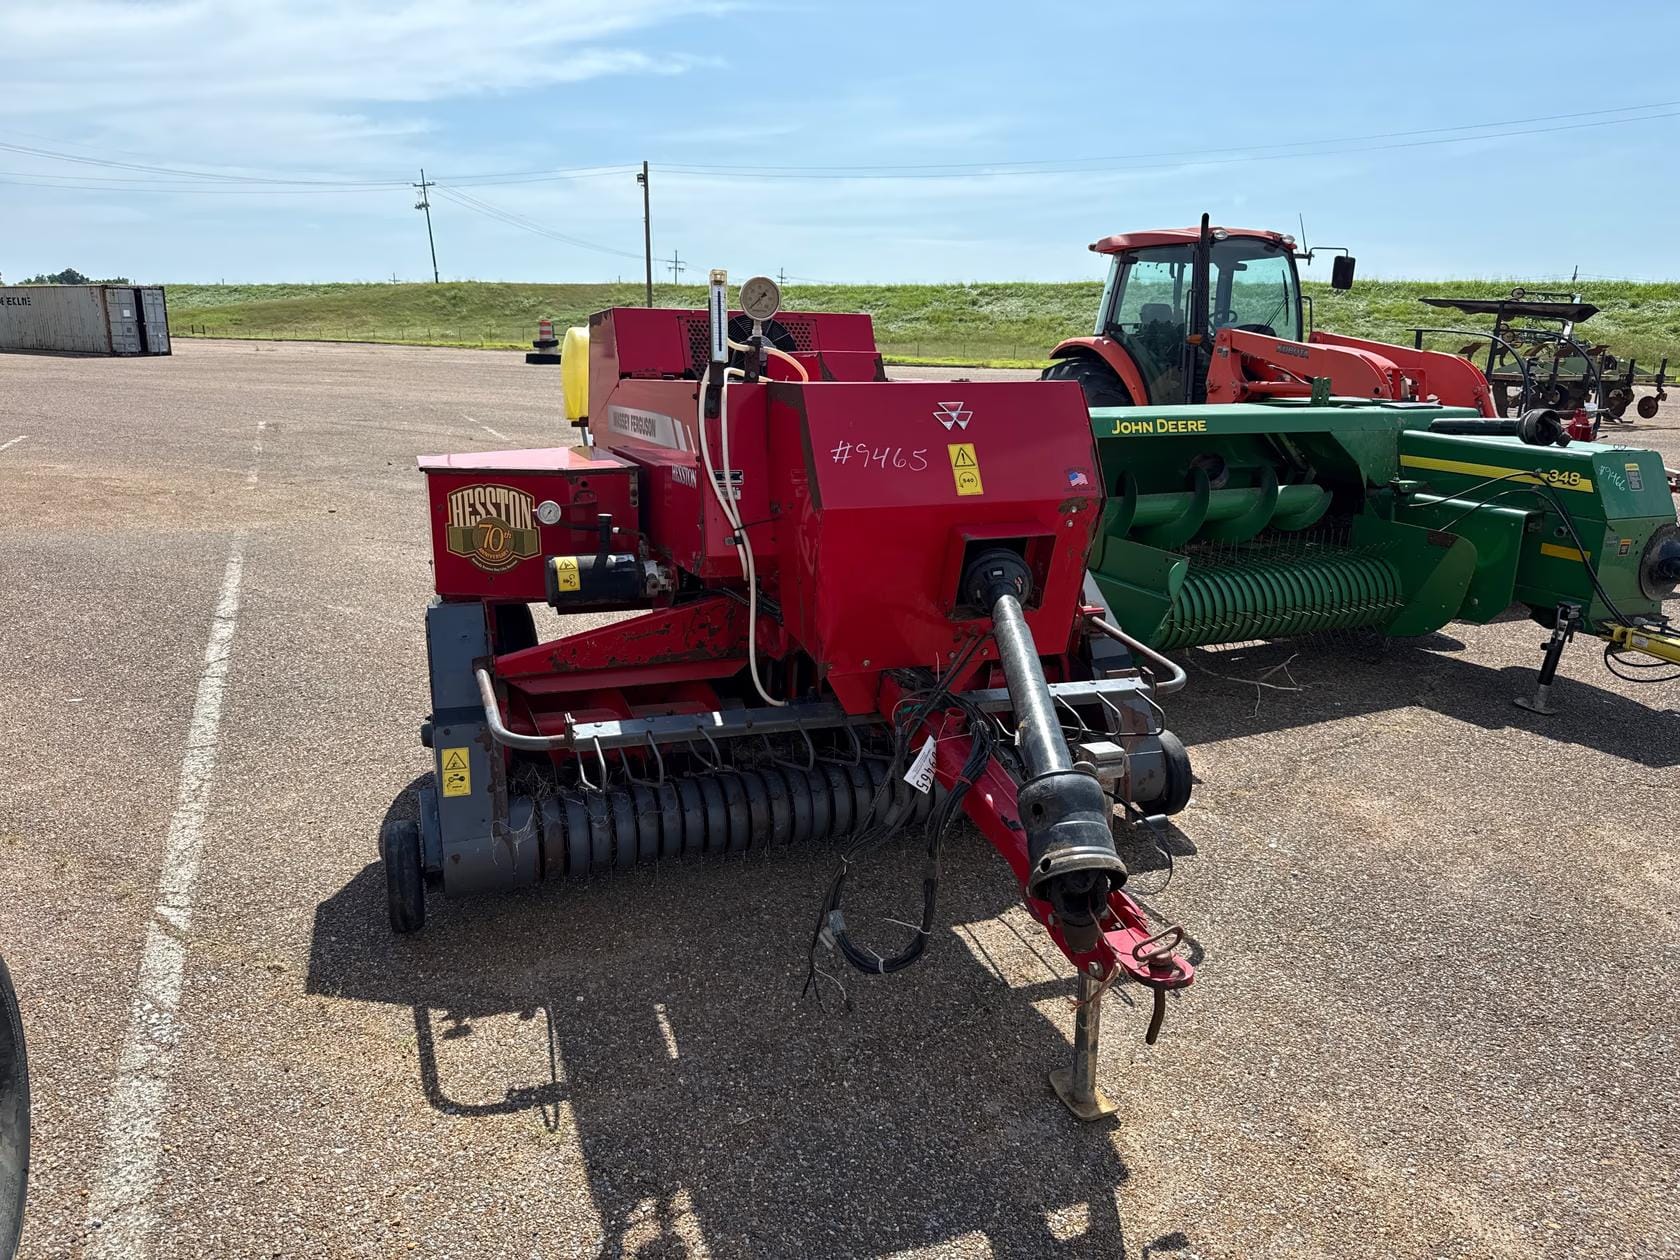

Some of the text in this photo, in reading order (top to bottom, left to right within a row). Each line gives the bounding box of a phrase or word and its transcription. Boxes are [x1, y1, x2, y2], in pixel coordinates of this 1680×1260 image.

[630, 414, 656, 438] FERGUSON
[1111, 418, 1207, 434] JOHN DEERE
[830, 440, 928, 471] #9465
[671, 463, 697, 489] HESSTON
[1548, 469, 1581, 486] 348
[451, 487, 532, 530] HESSTON
